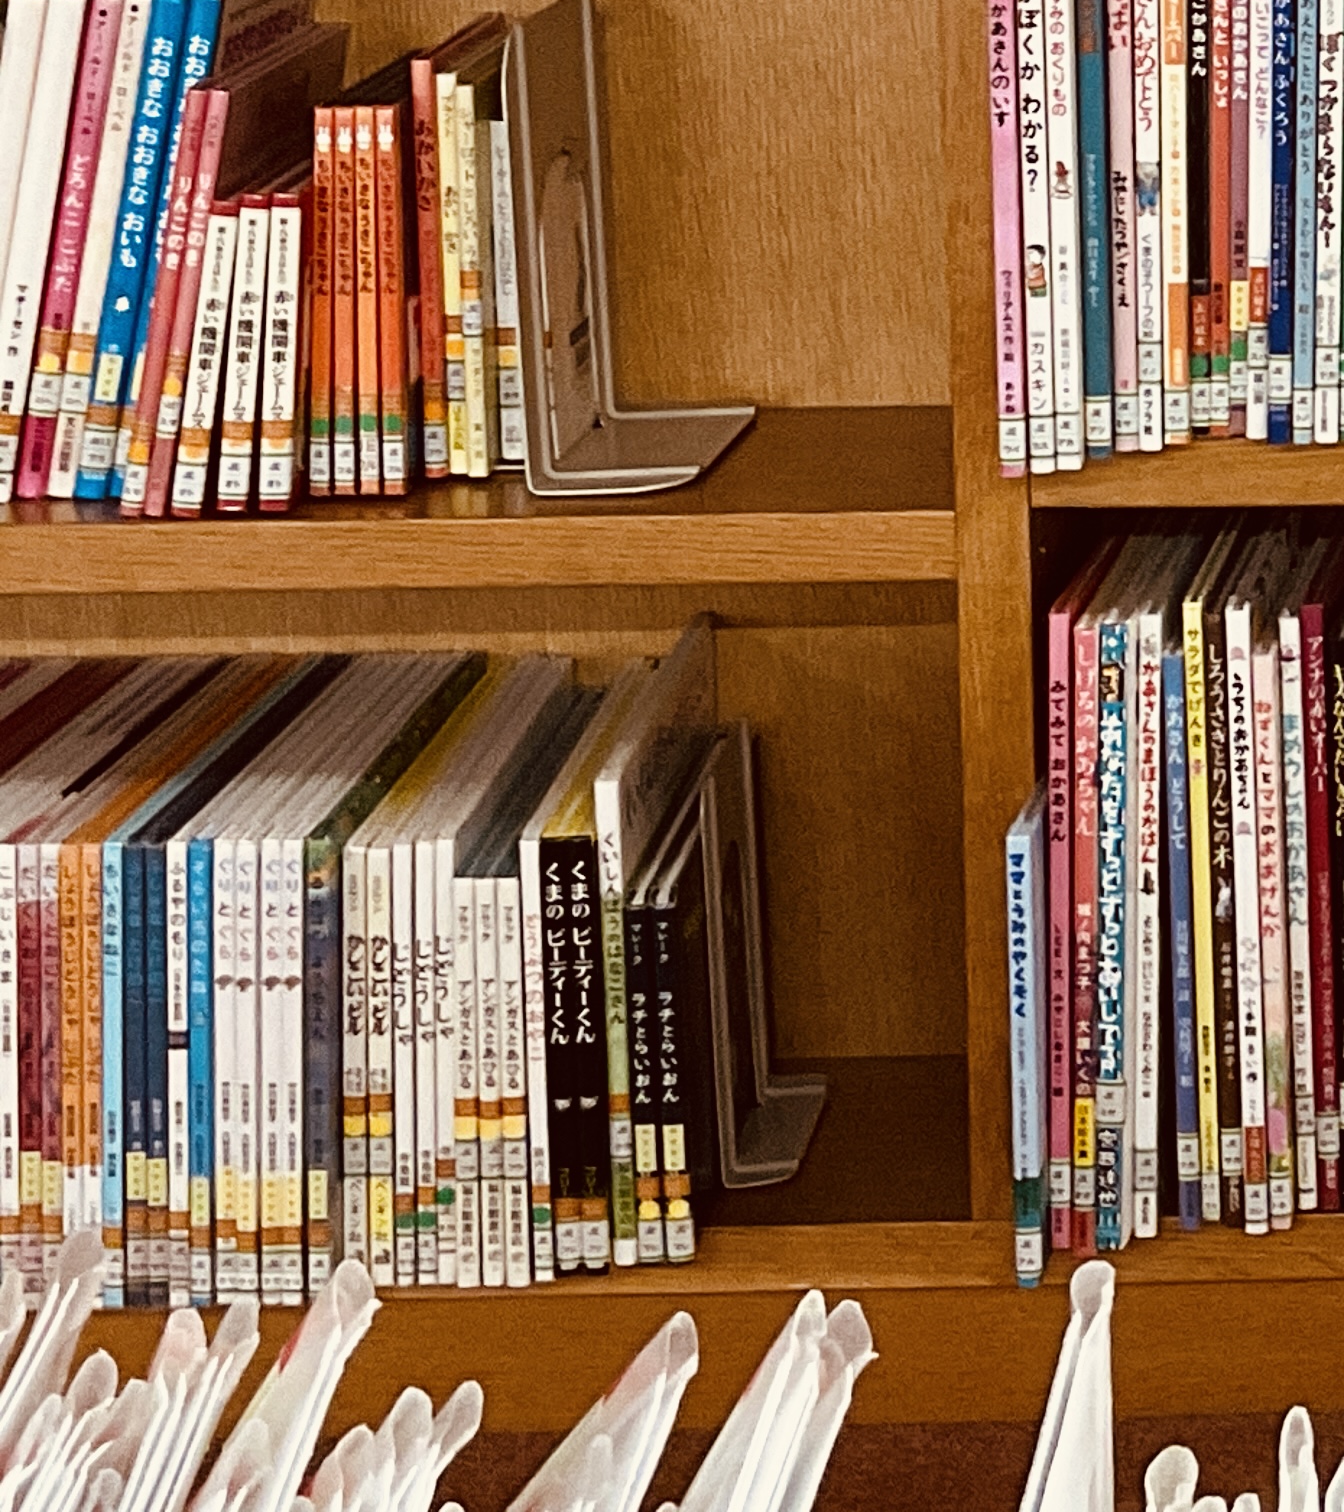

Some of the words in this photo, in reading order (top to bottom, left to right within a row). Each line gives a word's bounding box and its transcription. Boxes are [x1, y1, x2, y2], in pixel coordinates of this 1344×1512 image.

[141, 36, 174, 119] おおきな
[990, 3, 1011, 129] かあさんのいす
[1049, 41, 1068, 118] おくりもの
[1213, 53, 1229, 109] いっしょ
[1274, 71, 1290, 148] ふくろう
[127, 124, 159, 206] おおきな
[118, 212, 145, 269] おいも
[165, 175, 193, 271] りんごのき
[184, 173, 211, 268] りんごのき
[1050, 680, 1067, 747] みてみて
[1076, 643, 1096, 728] しげるの
[1187, 629, 1204, 748] サラダでげんき
[1075, 735, 1096, 838] かあちゃん
[1139, 661, 1161, 864] かあさんのまほうのかばん
[1206, 643, 1235, 870] しろうさぎとりんごの木
[1231, 672, 1251, 811] うちのおかあちゃん
[1051, 758, 1066, 843] おかあさん
[1170, 777, 1186, 851] どうして
[1281, 713, 1308, 926] まめうしのおかあさん
[169, 860, 186, 962] ふるやのもり
[544, 862, 565, 920] くまの
[570, 859, 591, 919] くまの
[601, 831, 627, 1025] くいしんぼうのはなこさん
[1008, 853, 1028, 1019] ママとうみのやくそく
[394, 942, 414, 1047] じどうしゃ
[415, 938, 437, 1046] じどうしゃ
[435, 934, 456, 1041] じどうしゃ
[456, 979, 474, 1090] アンガスとあひる
[480, 977, 497, 1088] アンガスとあひる
[503, 979, 520, 1090] アンガスとあひる
[630, 992, 653, 1105] ラチとらいおん
[656, 989, 681, 1104] ラチとらいおん
